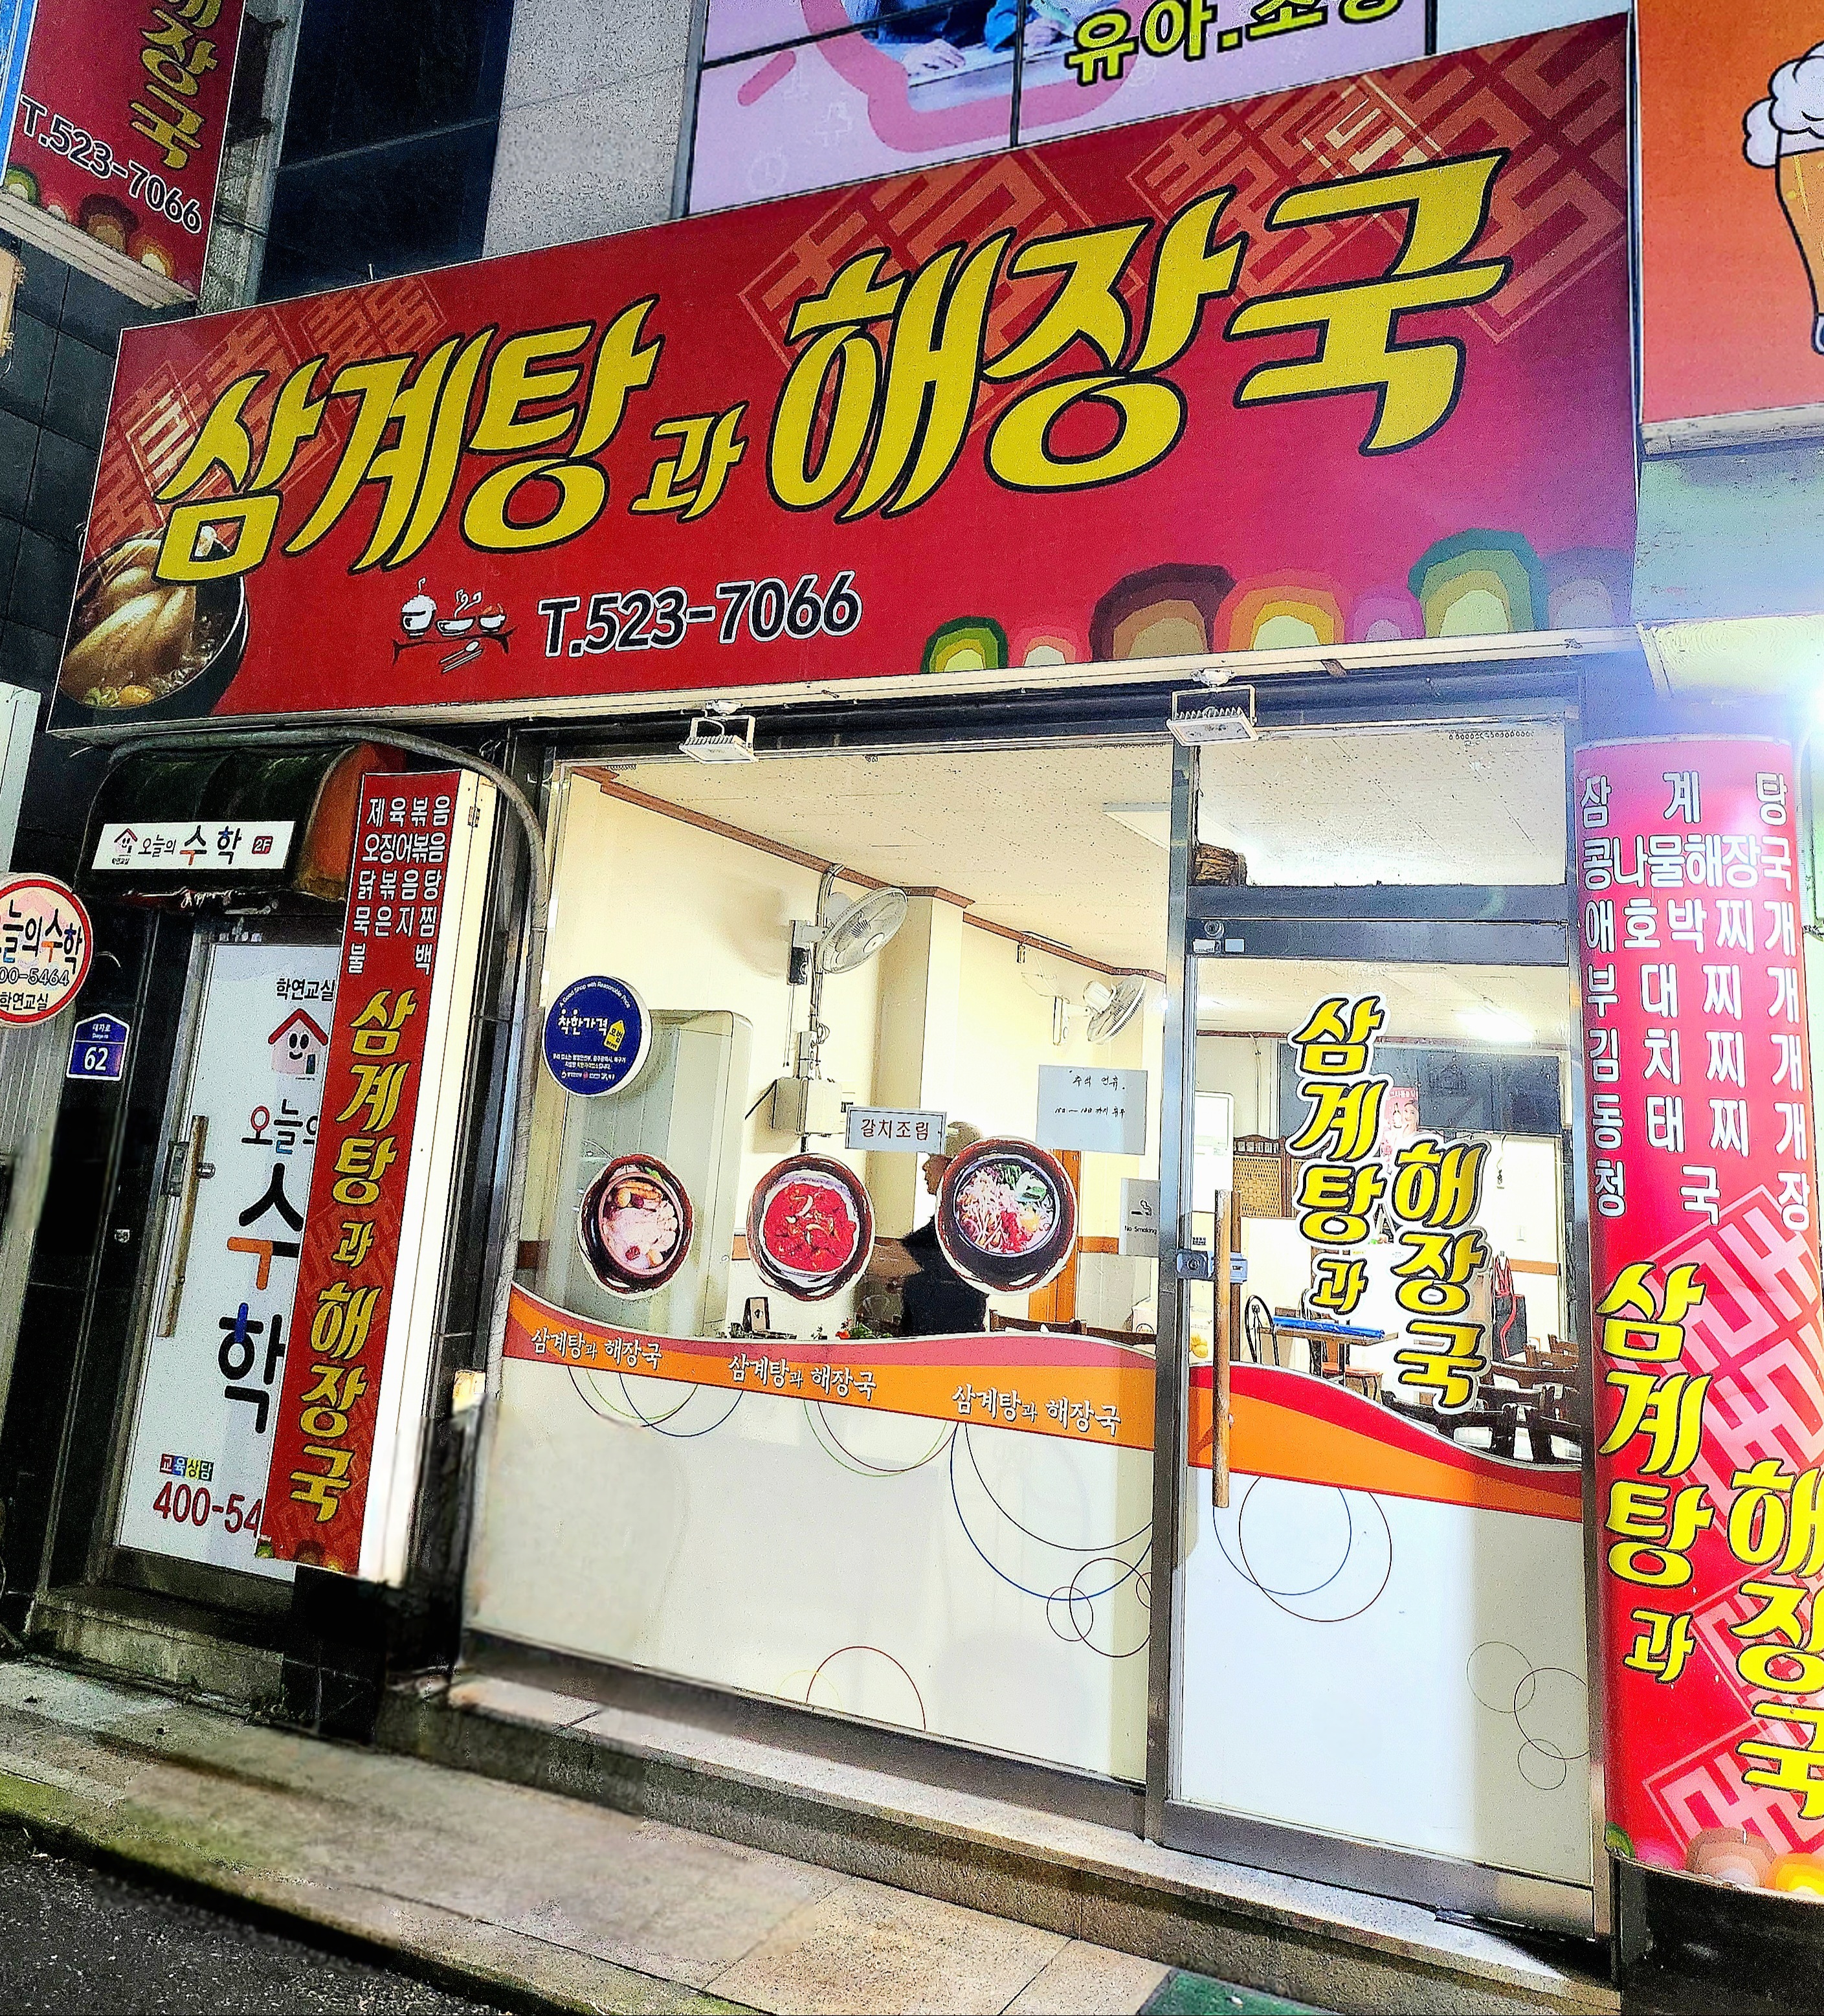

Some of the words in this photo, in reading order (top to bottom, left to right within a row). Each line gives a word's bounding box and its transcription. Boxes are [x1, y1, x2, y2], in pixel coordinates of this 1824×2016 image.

[19, 94, 202, 234] T.523-7066
[767, 148, 1513, 524] 해장국
[538, 570, 862, 657] T.523-7066
[138, 834, 177, 858] 오늘의
[179, 824, 242, 866] 수학
[253, 837, 272, 853] 2F
[362, 832, 446, 864] 오징어볶음
[1583, 833, 1792, 891] 콩나물해장국
[276, 978, 335, 1002] 학연교실
[562, 991, 575, 1003] Good
[573, 983, 586, 994] Shop
[557, 1008, 608, 1036] 착한가격
[84, 1046, 108, 1071] 62
[860, 1117, 929, 1141] 갈치조림
[1134, 1226, 1157, 1235] Smoking
[1390, 1137, 1488, 1409] 해장국
[604, 1336, 662, 1370] 해장국
[810, 1364, 877, 1401] 해장국
[290, 1281, 381, 1523] 해장국
[1045, 1396, 1122, 1437] 해장국
[159, 1453, 214, 1482] 교육상담
[1727, 1459, 1824, 1820] 해장국
